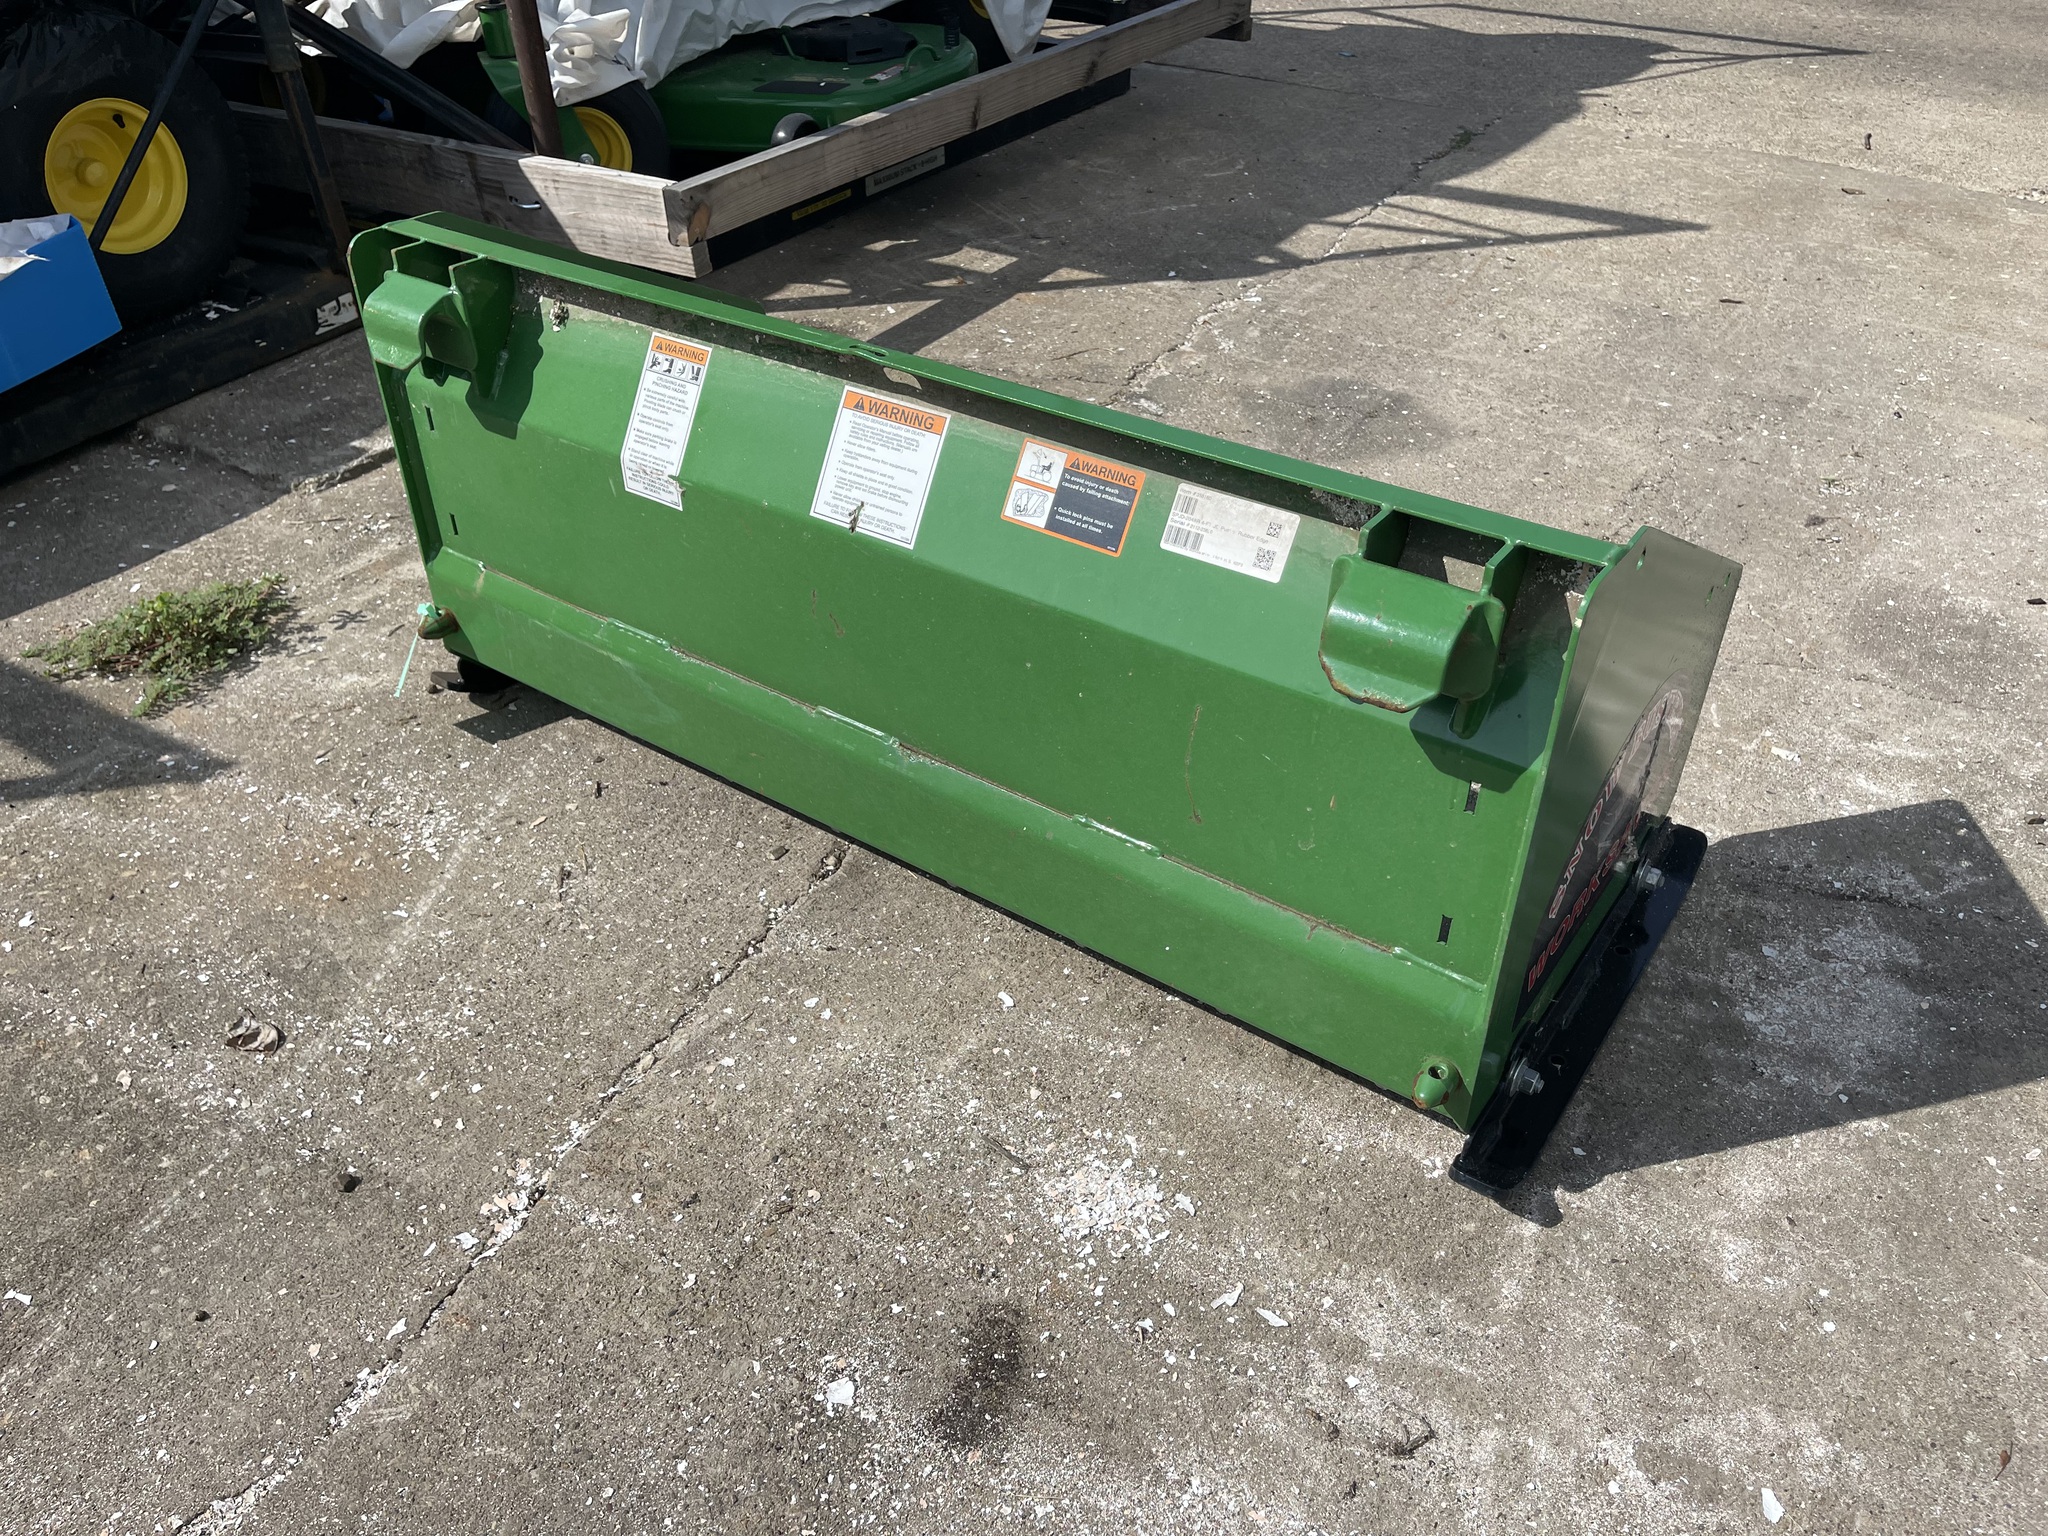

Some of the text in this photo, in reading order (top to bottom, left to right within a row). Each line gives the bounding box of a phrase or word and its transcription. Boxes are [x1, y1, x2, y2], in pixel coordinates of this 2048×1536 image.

[663, 342, 705, 361] WARNING
[866, 399, 935, 431] WARNING
[1079, 460, 1137, 486] WARNING
[1061, 480, 1079, 490] caused
[1085, 488, 1101, 497] falling
[1070, 475, 1084, 484] avoid
[1084, 479, 1098, 488] injury
[1104, 485, 1119, 494] death
[1055, 514, 1075, 525] installed
[1057, 507, 1072, 516] Quick
[1071, 511, 1082, 519] lock
[1082, 515, 1093, 523] pins
[1093, 518, 1106, 527] must
[1169, 518, 1185, 526] Serial
[1549, 752, 1627, 919] SNOW
